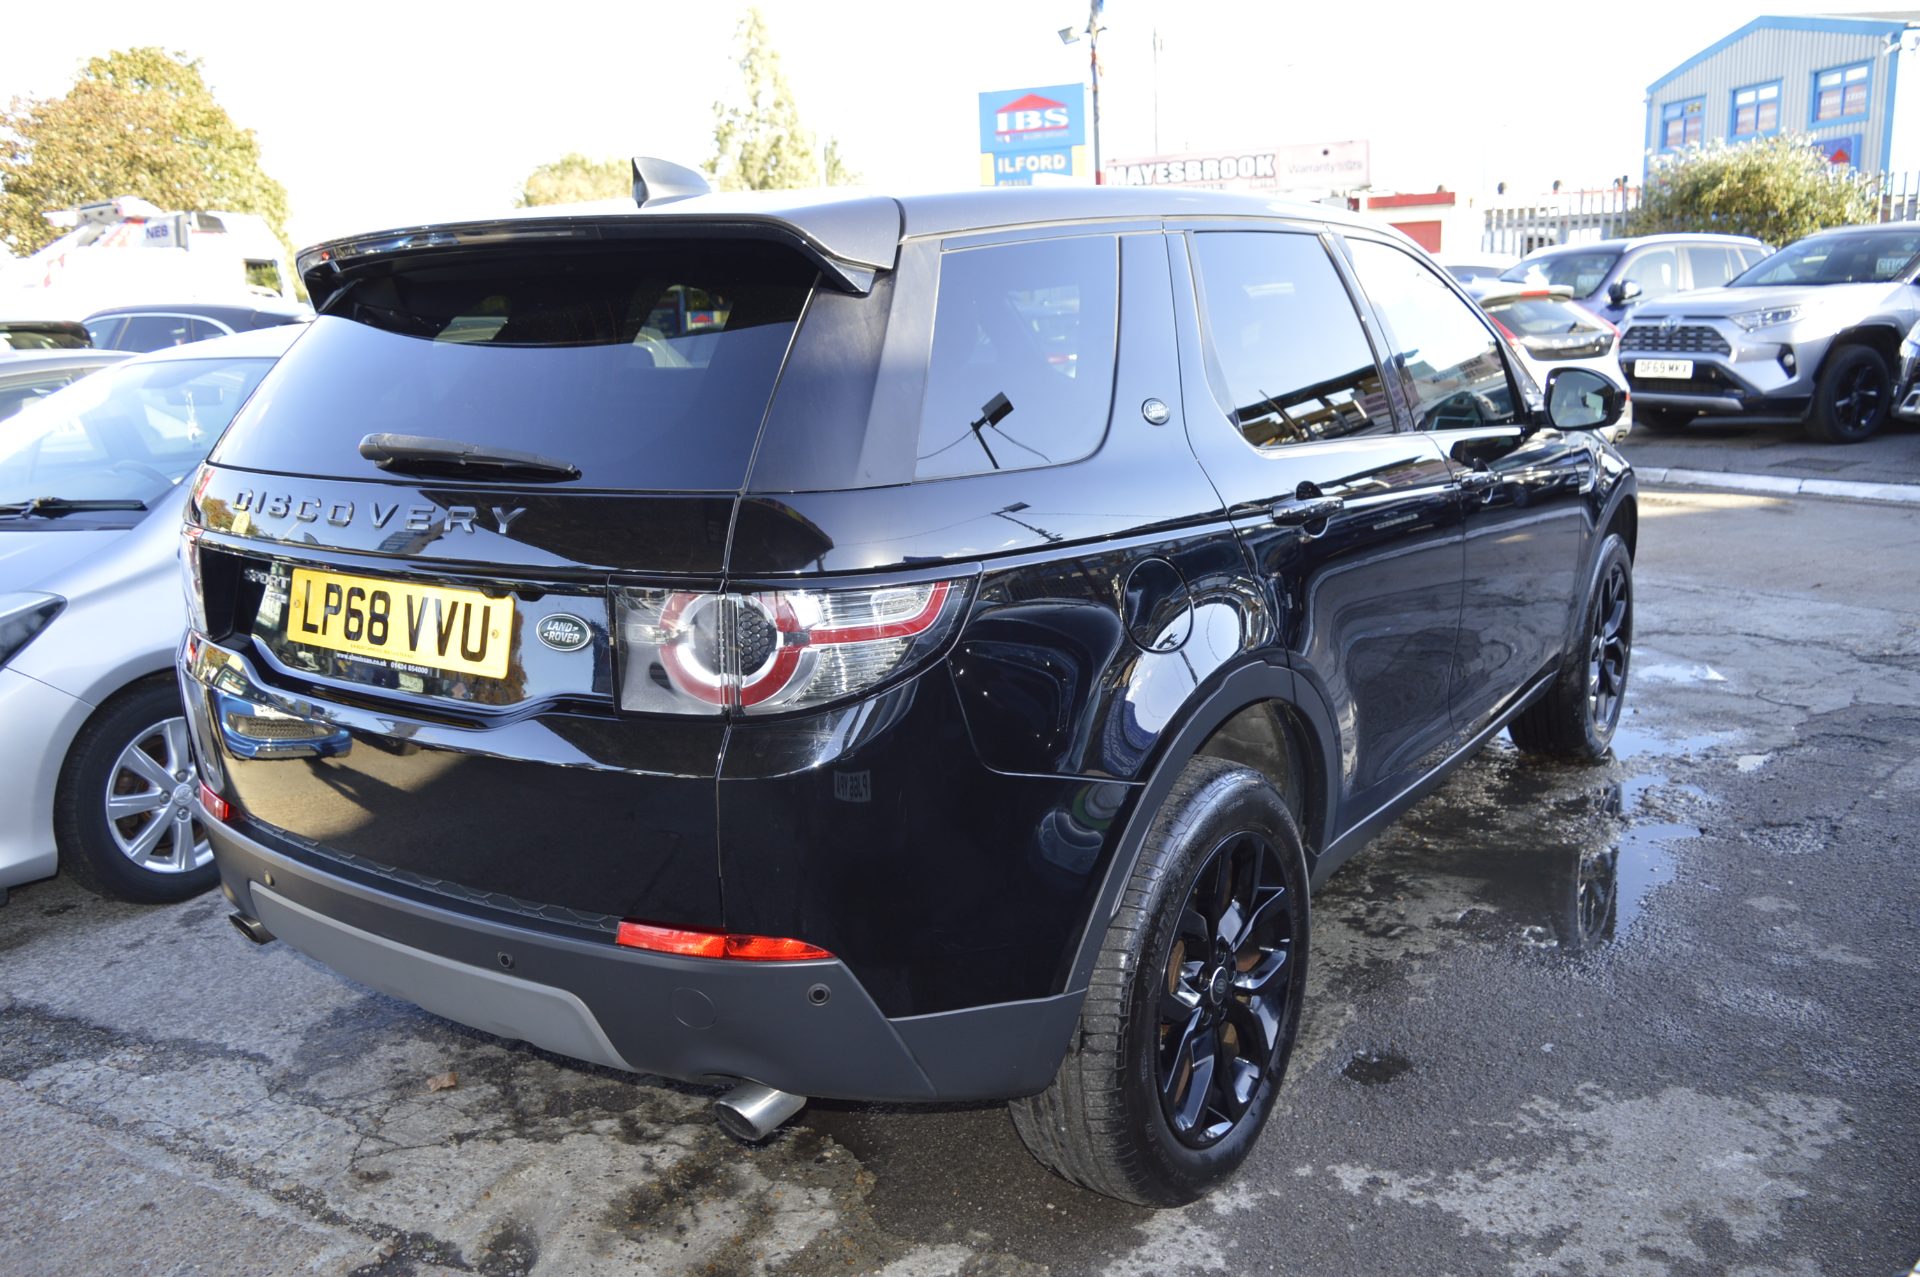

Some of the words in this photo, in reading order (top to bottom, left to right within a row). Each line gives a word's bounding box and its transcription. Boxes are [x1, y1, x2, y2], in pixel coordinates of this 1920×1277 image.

[995, 107, 1070, 132] IBS
[998, 153, 1066, 174] ILFORD
[1105, 153, 1276, 185] MAYESBROOK
[231, 488, 527, 535] DISCOVERY
[301, 579, 392, 646] LP68
[406, 594, 491, 663] VVU
[546, 620, 574, 632] LAND
[547, 631, 581, 643] ROVER
